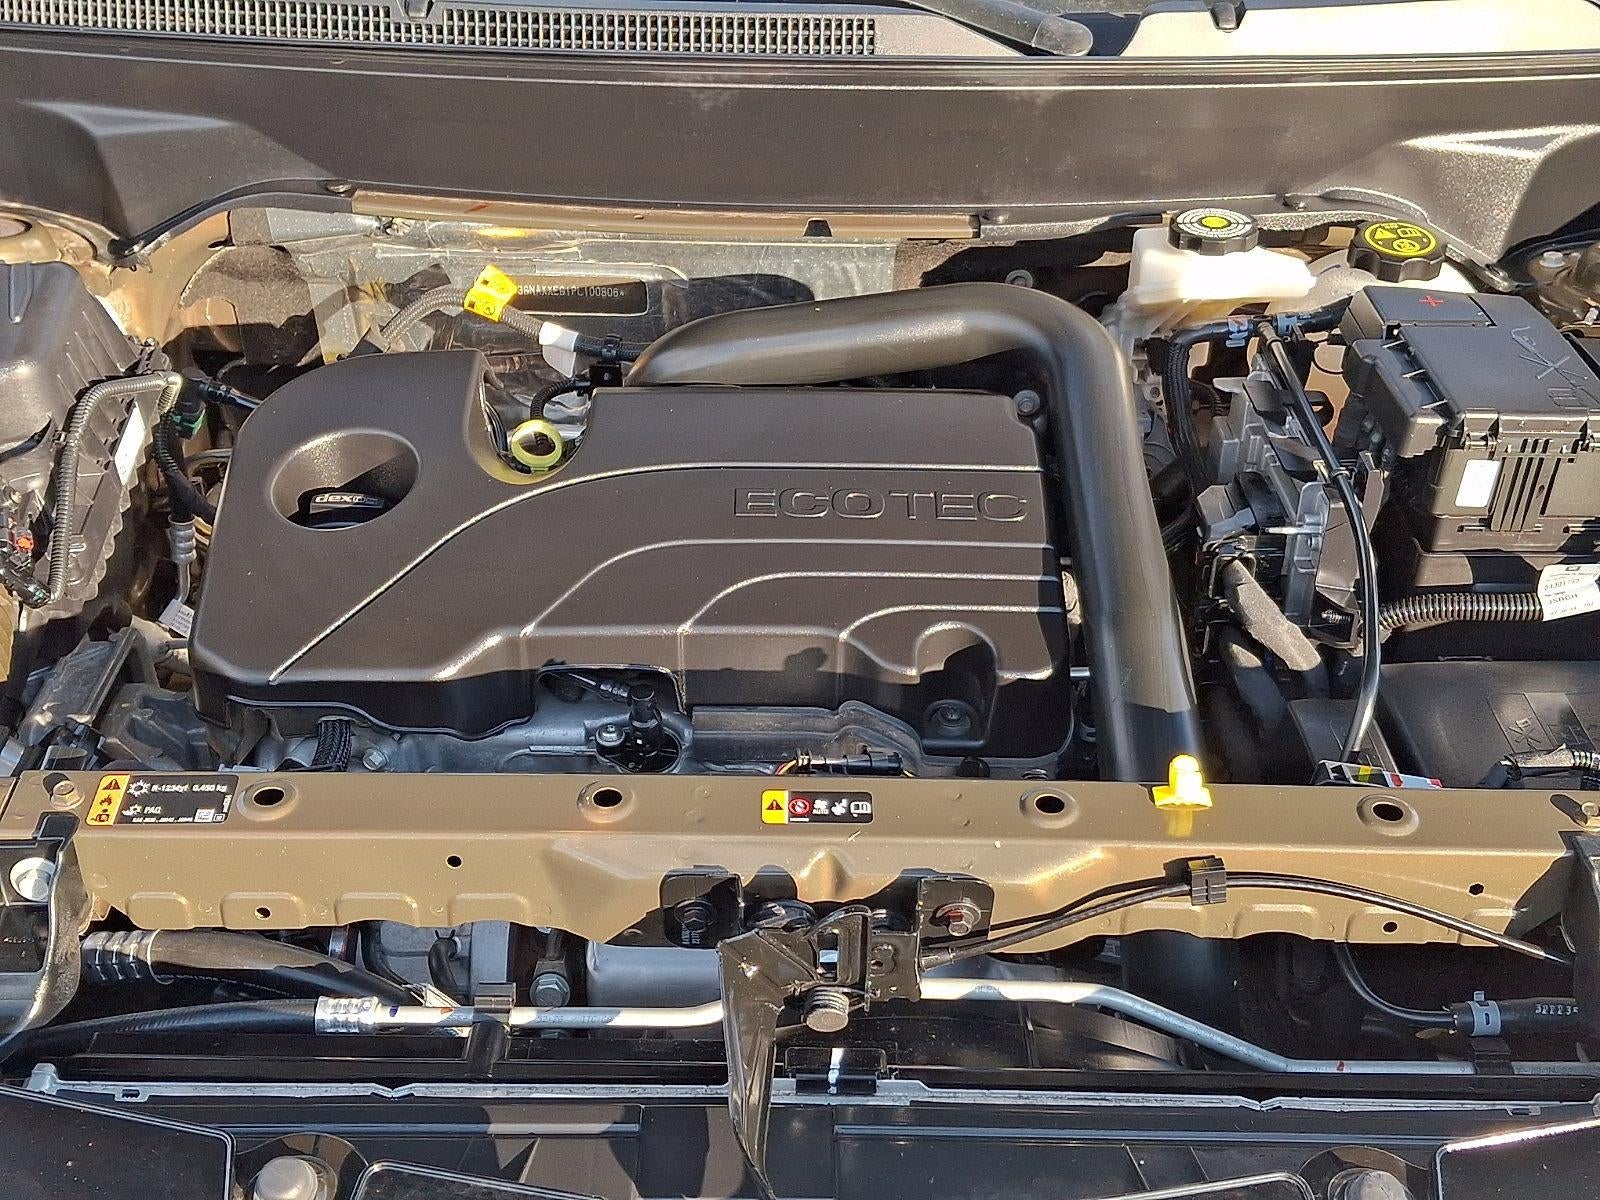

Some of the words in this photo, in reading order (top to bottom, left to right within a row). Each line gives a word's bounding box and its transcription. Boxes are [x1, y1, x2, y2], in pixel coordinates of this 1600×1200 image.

[733, 487, 1028, 522] ECOTEC
[151, 784, 189, 794] R-1234yf
[192, 784, 215, 792] 0.450
[216, 784, 228, 793] kg
